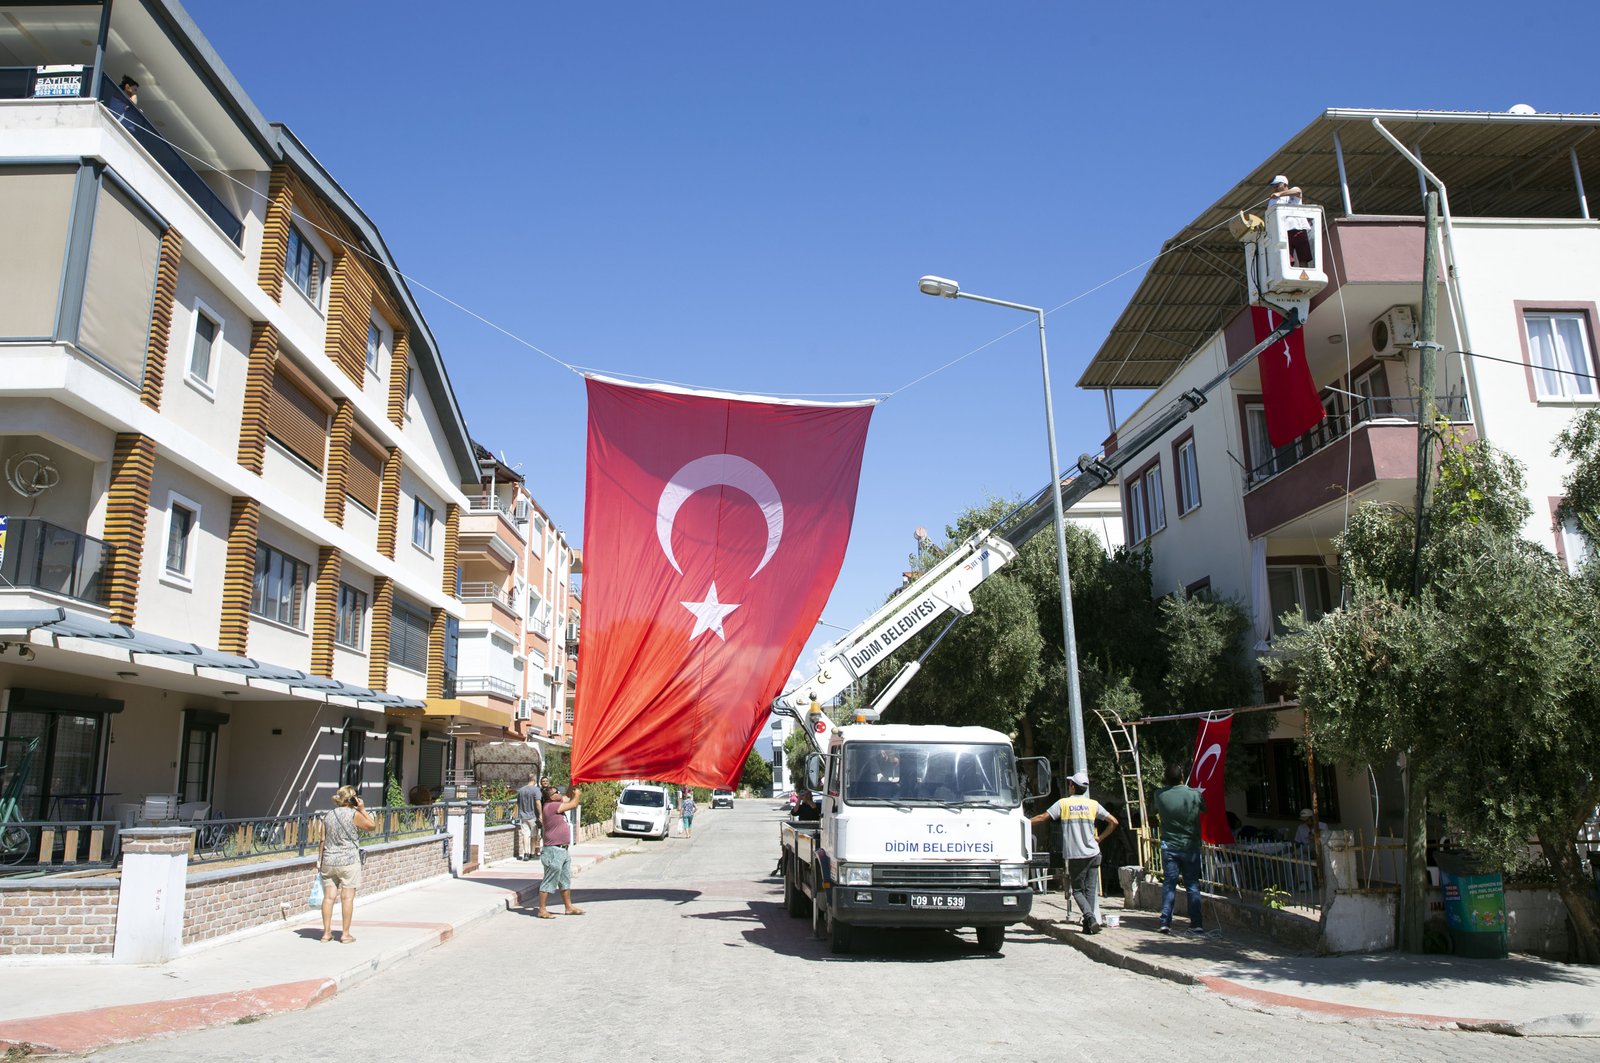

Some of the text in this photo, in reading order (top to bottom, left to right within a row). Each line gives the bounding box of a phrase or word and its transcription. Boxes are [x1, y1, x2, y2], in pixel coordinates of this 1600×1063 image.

[37, 77, 82, 85] SATILIK
[926, 824, 947, 834] T.C.
[885, 840, 993, 853] DİDİM BELEDİYESİ
[916, 896, 928, 905] 09
[932, 896, 943, 906] YC
[947, 897, 964, 906] 539
